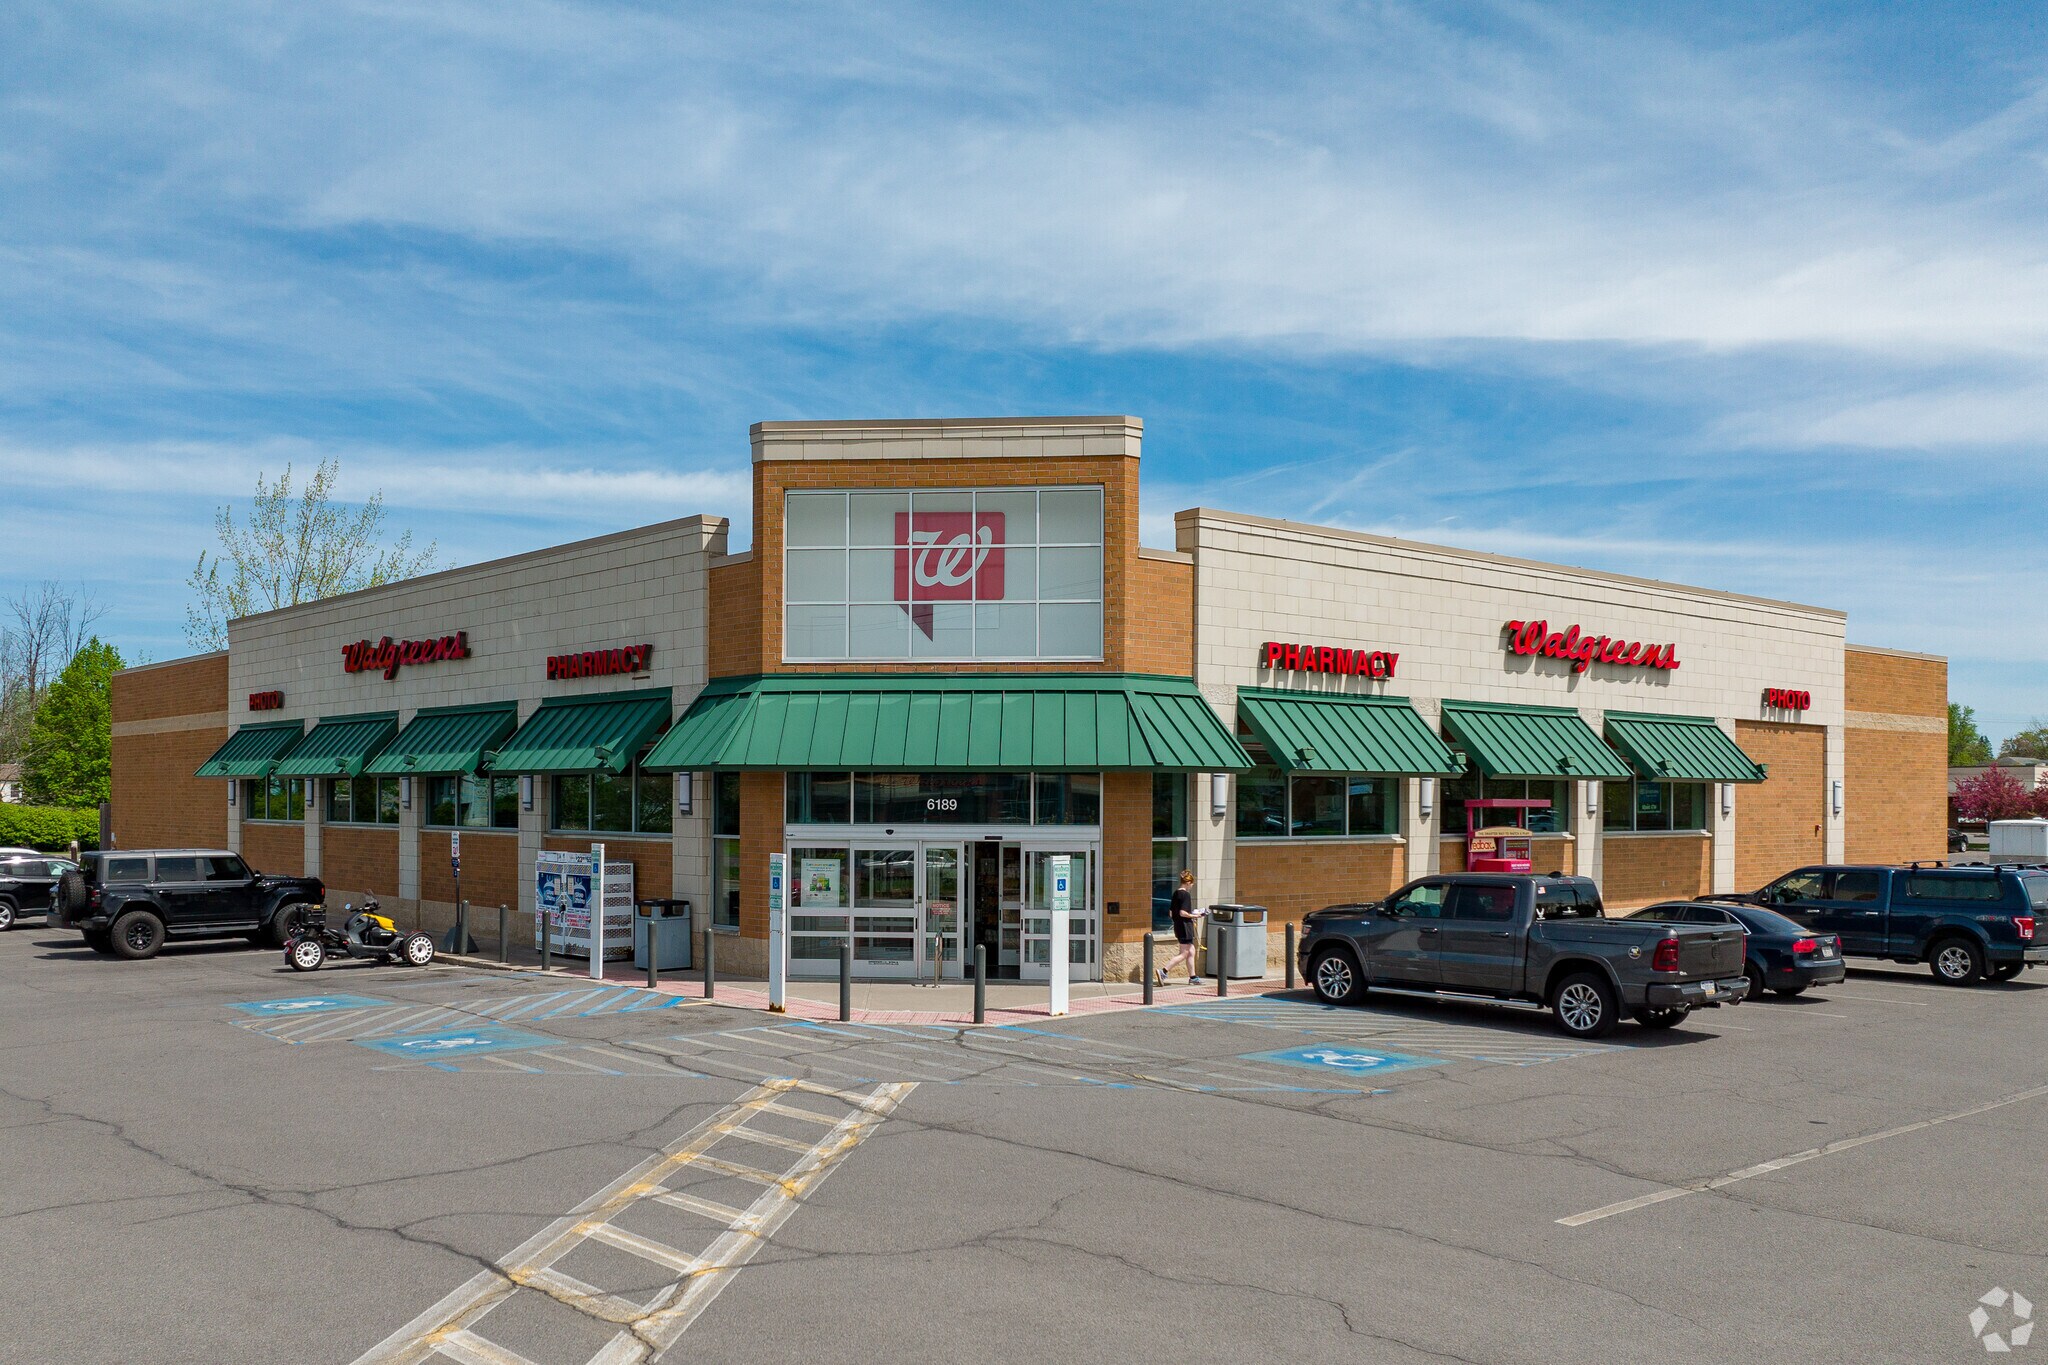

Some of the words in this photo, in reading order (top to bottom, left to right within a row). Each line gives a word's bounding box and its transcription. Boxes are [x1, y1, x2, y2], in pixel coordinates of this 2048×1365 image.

[342, 631, 470, 680] Walgreens
[546, 643, 650, 680] PHARMACY
[1267, 641, 1399, 678] PHARMACY
[1508, 619, 1681, 673] Walgreens
[249, 690, 283, 711] PHOTO
[1769, 687, 1811, 711] PHOTO
[926, 798, 958, 811] 6189
